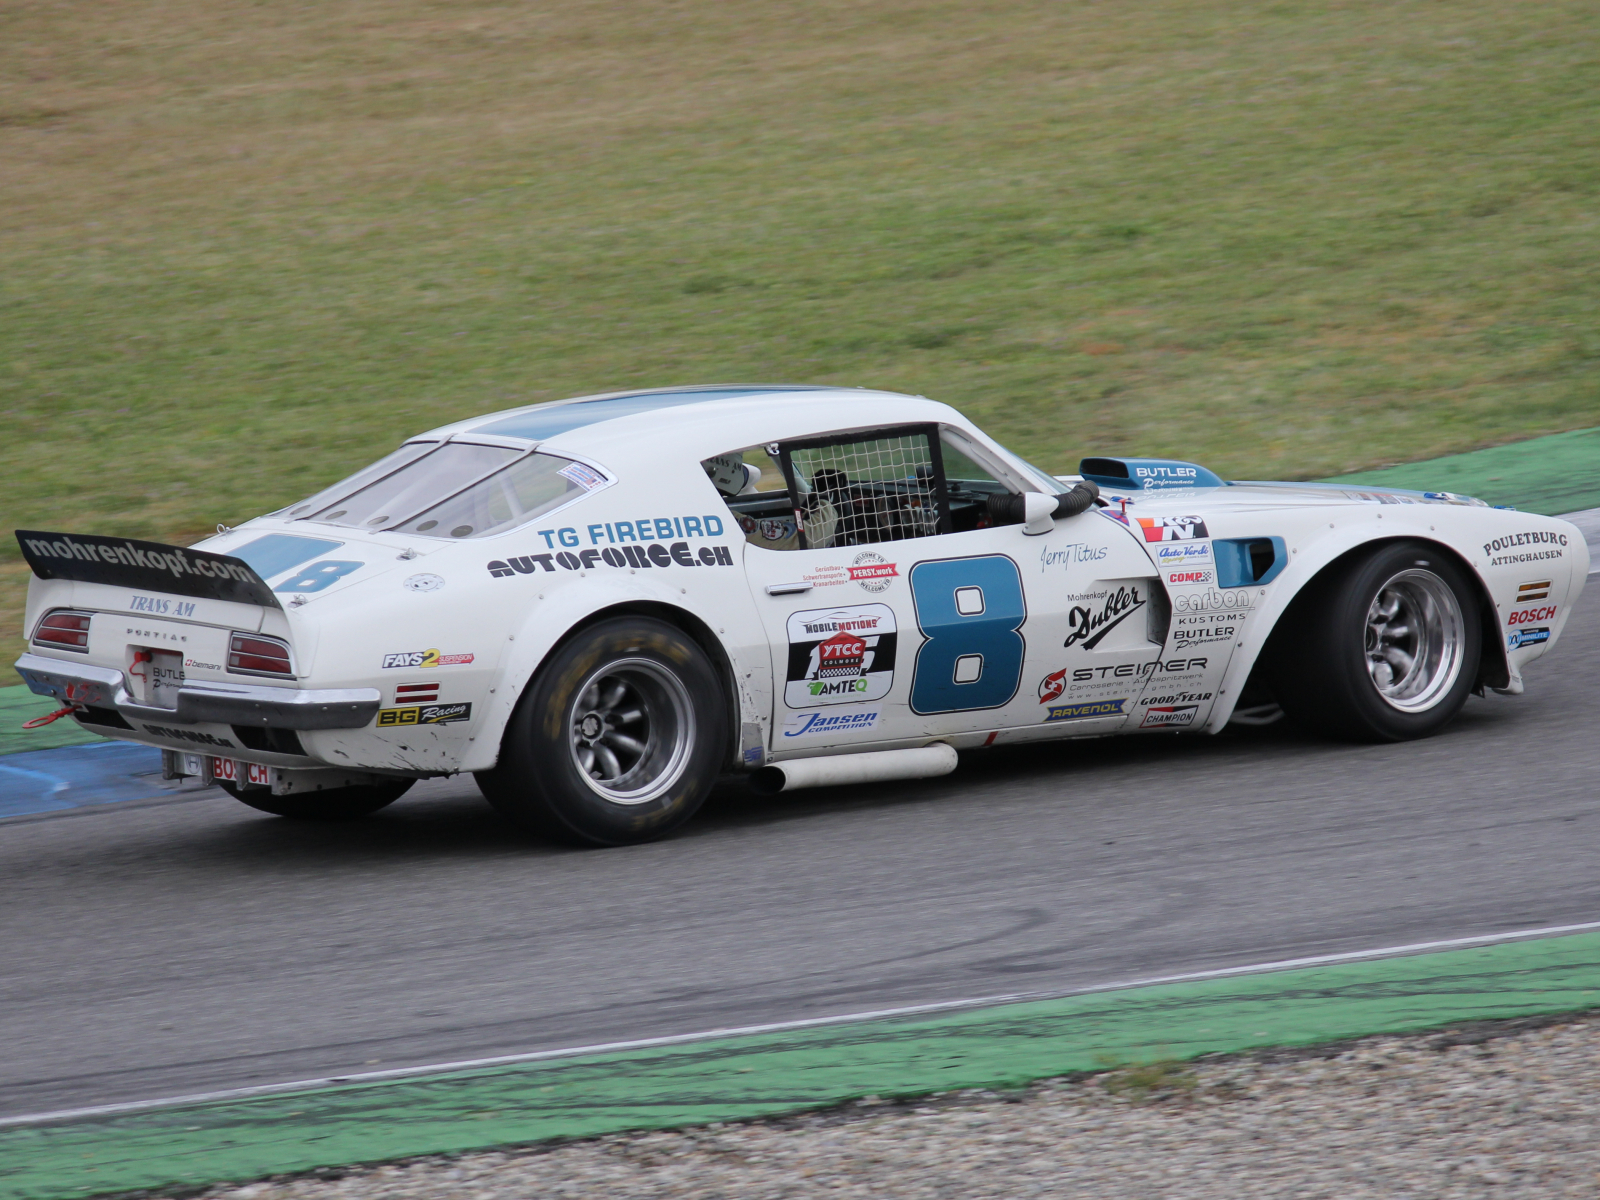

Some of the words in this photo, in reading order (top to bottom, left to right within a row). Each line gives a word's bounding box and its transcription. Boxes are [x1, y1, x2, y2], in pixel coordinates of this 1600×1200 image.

[706, 457, 729, 468] RANS
[1136, 467, 1197, 478] BUTLER
[1143, 478, 1195, 489] Performance
[537, 527, 580, 548] TG
[588, 515, 724, 544] FIREBIRD
[1153, 515, 1203, 540] K&N
[1160, 547, 1183, 557] Auto
[1184, 545, 1208, 555] Verdi
[1483, 532, 1568, 556] POULETBURG
[25, 537, 256, 584] mohrenkopf.com
[854, 552, 876, 565] WELCOME
[877, 555, 885, 563] TO
[1040, 545, 1070, 573] Jerry
[1066, 543, 1108, 562] Titus
[1491, 549, 1563, 566] ATTINGHAUSEN
[273, 560, 365, 593] 8
[852, 566, 894, 578] PERSY.work
[1170, 572, 1202, 583] COMP
[813, 580, 845, 588] Kranarbeiten
[860, 581, 885, 592] WELCOME
[1067, 589, 1108, 602] Mohrenkopf
[1175, 587, 1249, 612] carbon
[130, 595, 171, 614] TRANS
[172, 600, 195, 617] AM
[1064, 586, 1146, 649] Dubler
[1179, 613, 1246, 625] KUSTOMS
[1508, 605, 1557, 625] BOSCH
[126, 628, 187, 642] PONTIAC
[909, 553, 1027, 716] 8
[1174, 627, 1234, 640] BUTLER
[1520, 631, 1548, 641] MINILITE
[823, 643, 862, 658] YTCC
[1175, 636, 1232, 652] Performance
[824, 658, 859, 666] COLMORE
[153, 667, 185, 680] BUTLE
[1073, 658, 1207, 682] STEINER
[1070, 680, 1124, 692] Carrosserie
[421, 705, 467, 720] Racing
[1052, 703, 1118, 718] RAVENOL
[784, 712, 878, 737] Jansen
[1146, 713, 1193, 723] CHAMPION
[808, 721, 874, 733] COMPETITION
